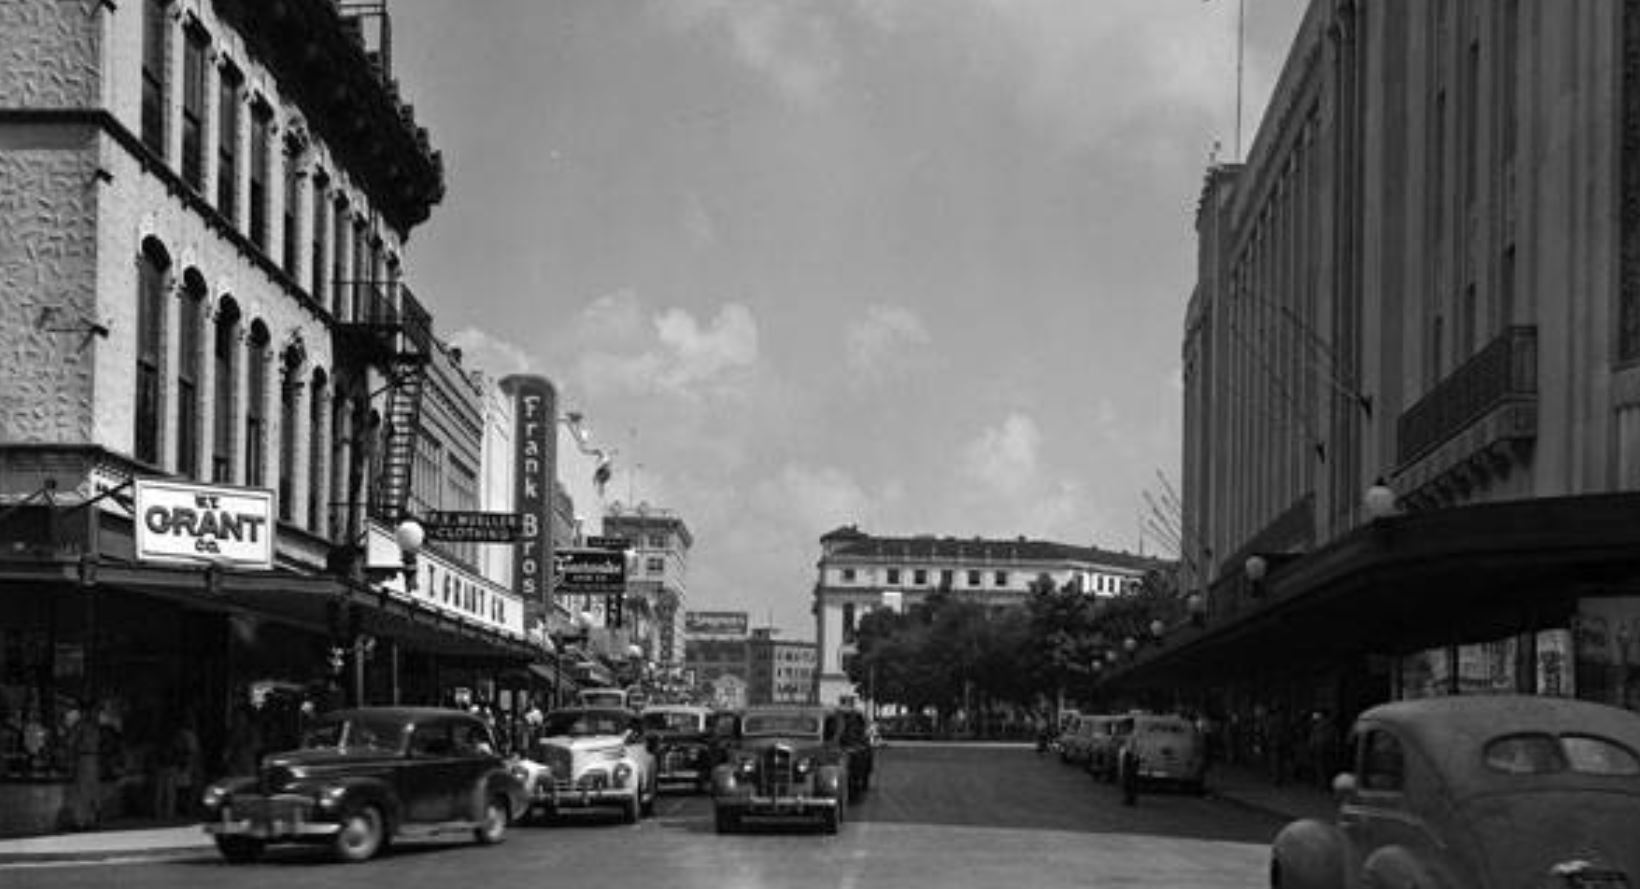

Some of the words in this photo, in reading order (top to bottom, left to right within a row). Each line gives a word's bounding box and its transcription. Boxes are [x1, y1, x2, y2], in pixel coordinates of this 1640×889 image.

[523, 396, 541, 499] Frank
[145, 505, 265, 542] GRANT
[521, 513, 539, 594] Bros
